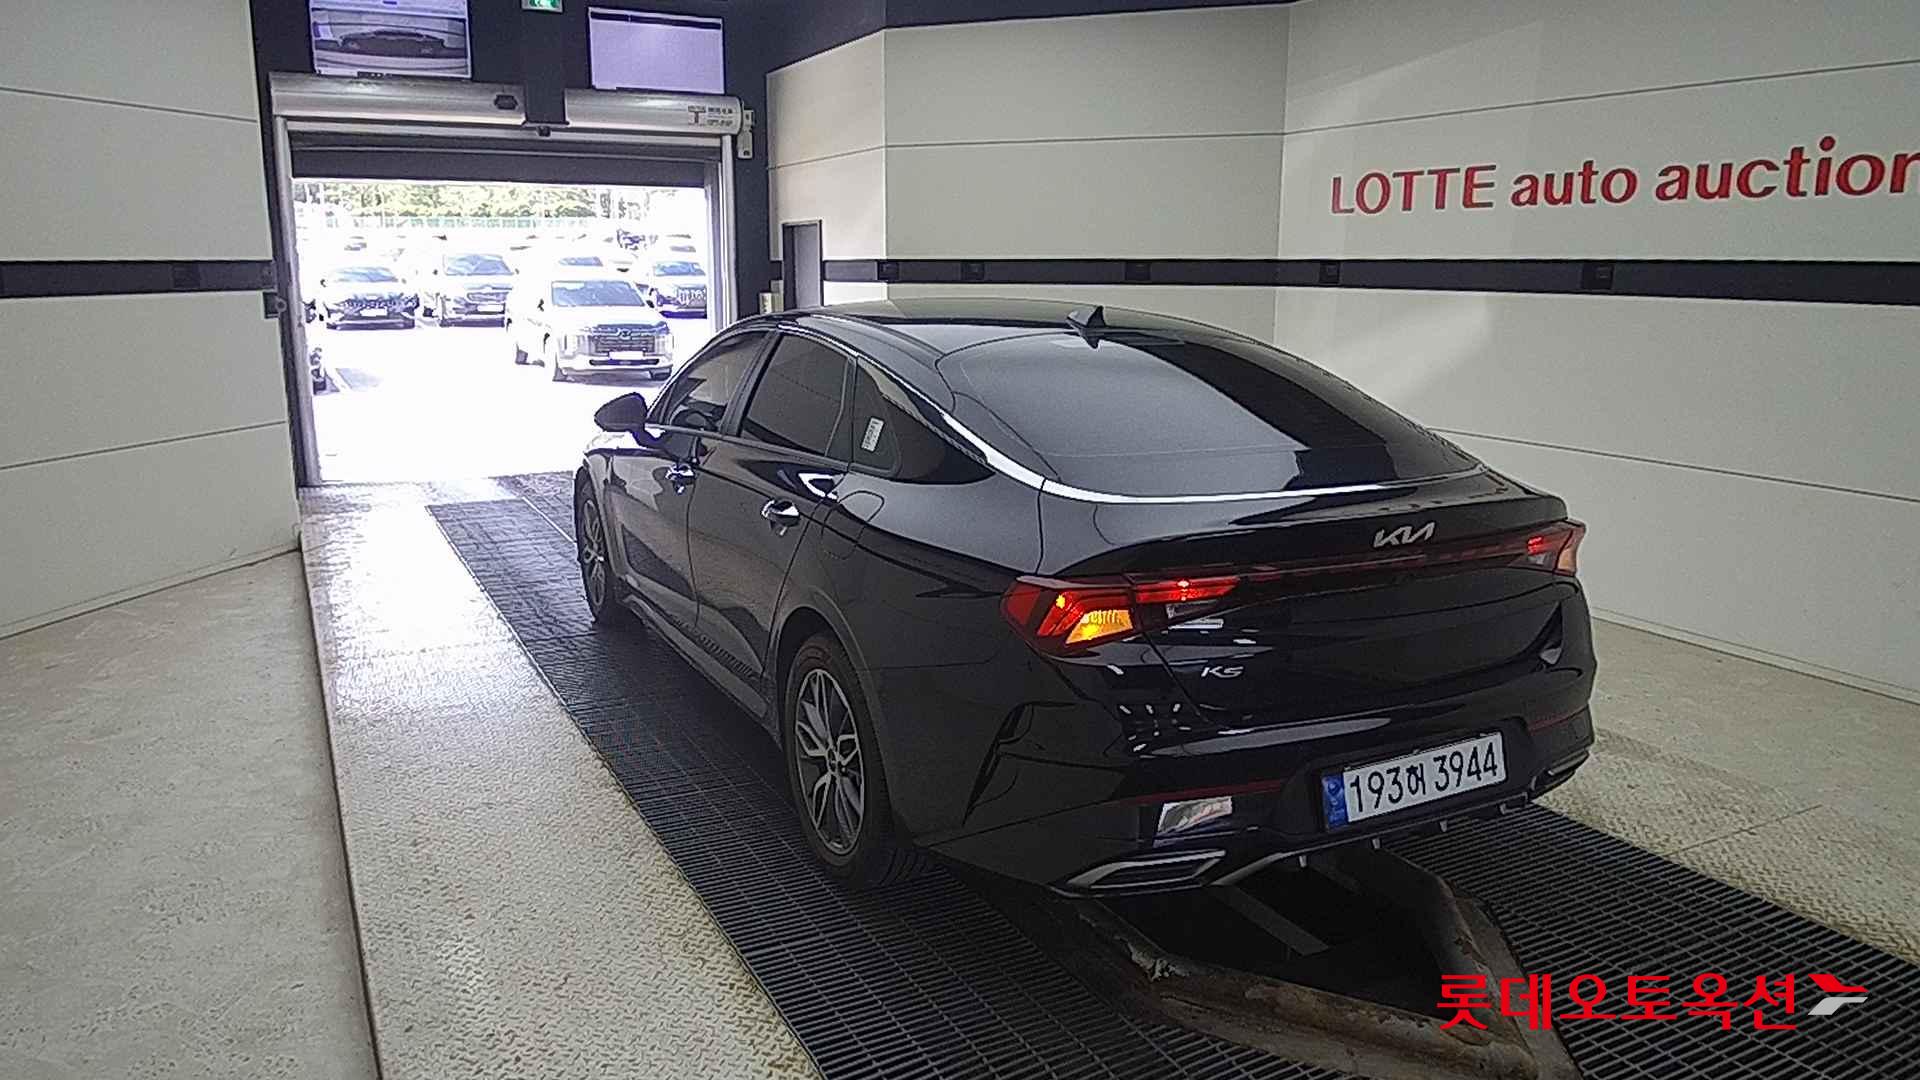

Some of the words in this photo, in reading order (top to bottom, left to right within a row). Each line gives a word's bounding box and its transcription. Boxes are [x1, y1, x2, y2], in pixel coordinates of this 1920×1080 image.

[1331, 165, 1497, 215] LOTTE
[1510, 159, 1638, 207] auto
[1373, 521, 1436, 548] KIA
[1433, 742, 1498, 792] 3944
